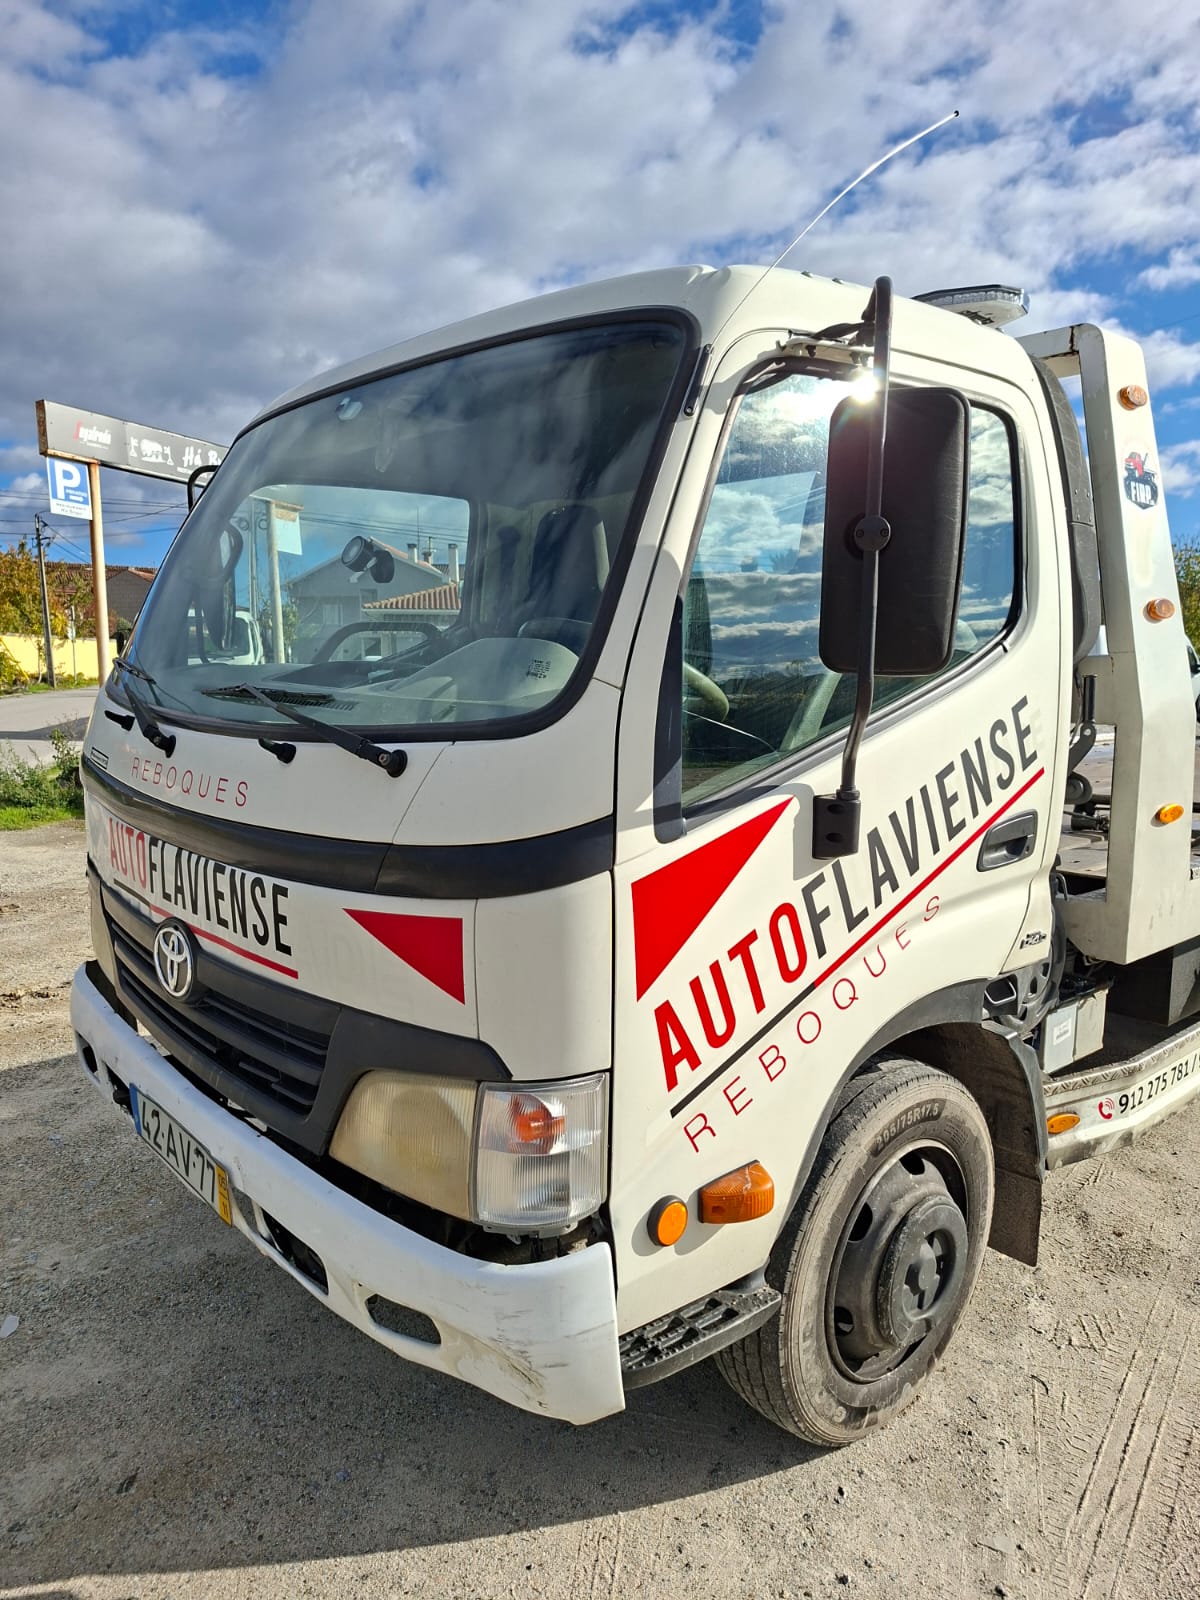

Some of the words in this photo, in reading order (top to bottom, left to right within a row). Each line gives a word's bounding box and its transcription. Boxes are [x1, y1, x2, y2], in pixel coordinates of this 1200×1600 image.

[54, 460, 81, 500] P
[131, 756, 249, 807] REBOQUES
[109, 817, 292, 956] AUTOFLAVIENSE
[653, 695, 1039, 1092] AUTOFLAVIENSE
[683, 895, 940, 1152] REBOQUES
[1119, 1085, 1144, 1114] 912
[1147, 1072, 1167, 1100] 275
[1171, 1059, 1189, 1085] 781
